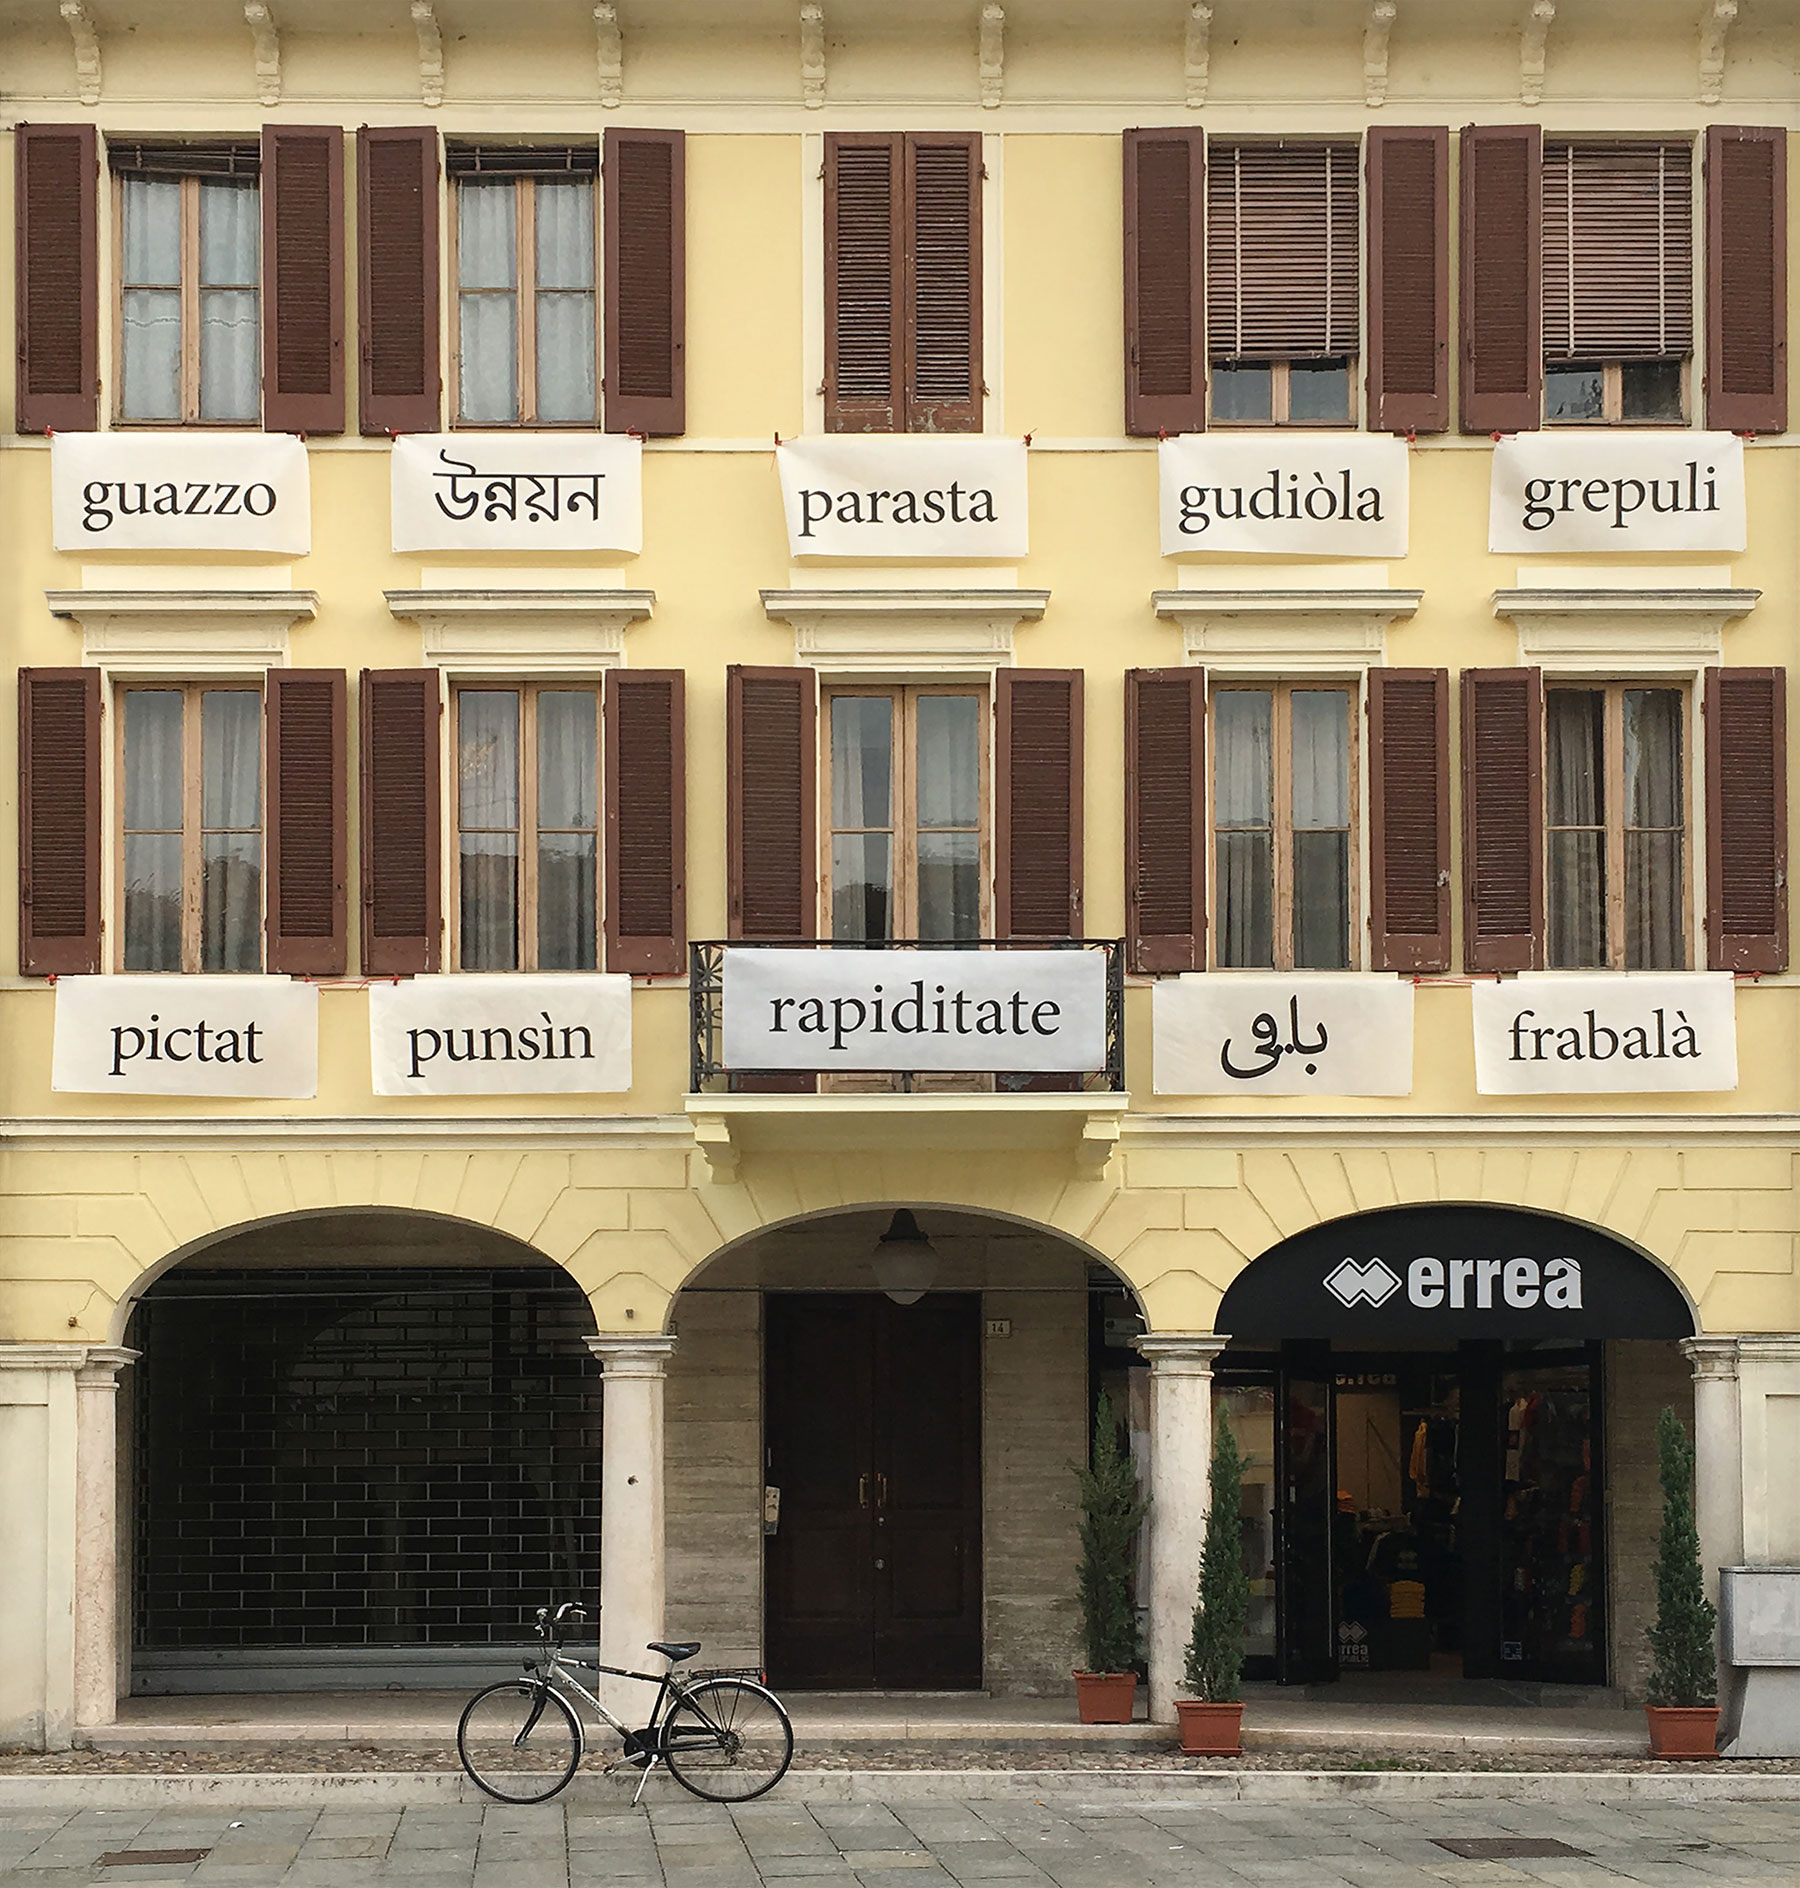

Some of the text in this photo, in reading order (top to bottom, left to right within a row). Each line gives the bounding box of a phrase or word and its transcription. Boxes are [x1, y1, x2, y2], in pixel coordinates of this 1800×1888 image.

[83, 482, 276, 531] guazzo
[433, 448, 606, 523] উন্নয়ন
[799, 482, 997, 536] parasta
[1179, 470, 1384, 534] gudiòla
[1523, 462, 1719, 530] grepuli
[109, 1015, 263, 1075] pictat
[407, 1012, 594, 1077] punsìn
[769, 981, 1060, 1049] rapiditate
[1509, 1009, 1701, 1060] frabalà
[992, 1322, 1003, 1333] 14
